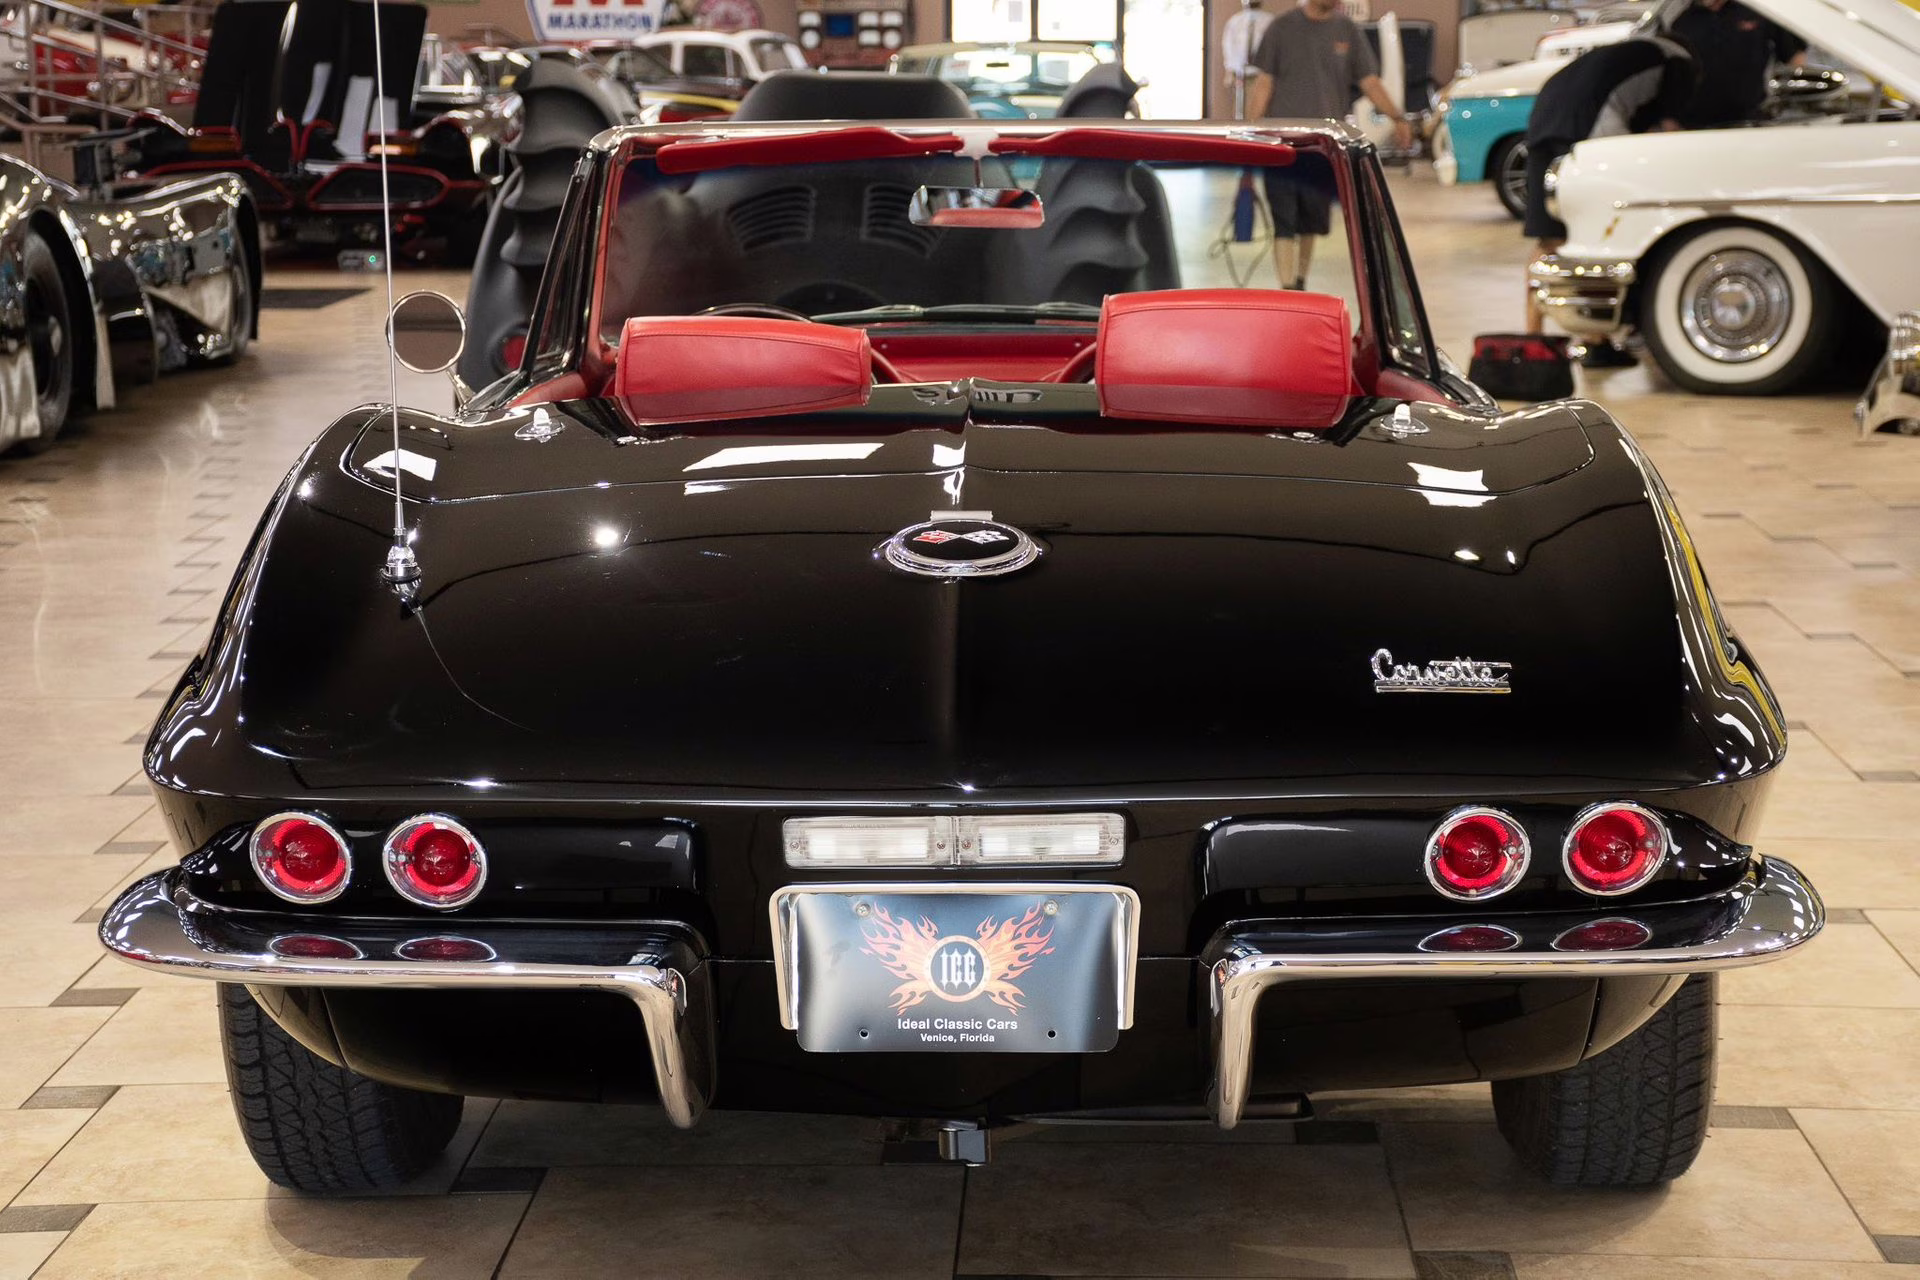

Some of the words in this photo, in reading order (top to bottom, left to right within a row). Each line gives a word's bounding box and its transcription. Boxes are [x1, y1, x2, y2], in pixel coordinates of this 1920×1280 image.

[548, 13, 653, 30] MARATHON
[1371, 648, 1512, 688] Corvette
[897, 1018, 930, 1030] Ideal
[934, 1018, 983, 1030] Classic
[986, 1018, 1018, 1030] Cars
[920, 1033, 957, 1043] Venice,
[959, 1033, 995, 1042] Florida
